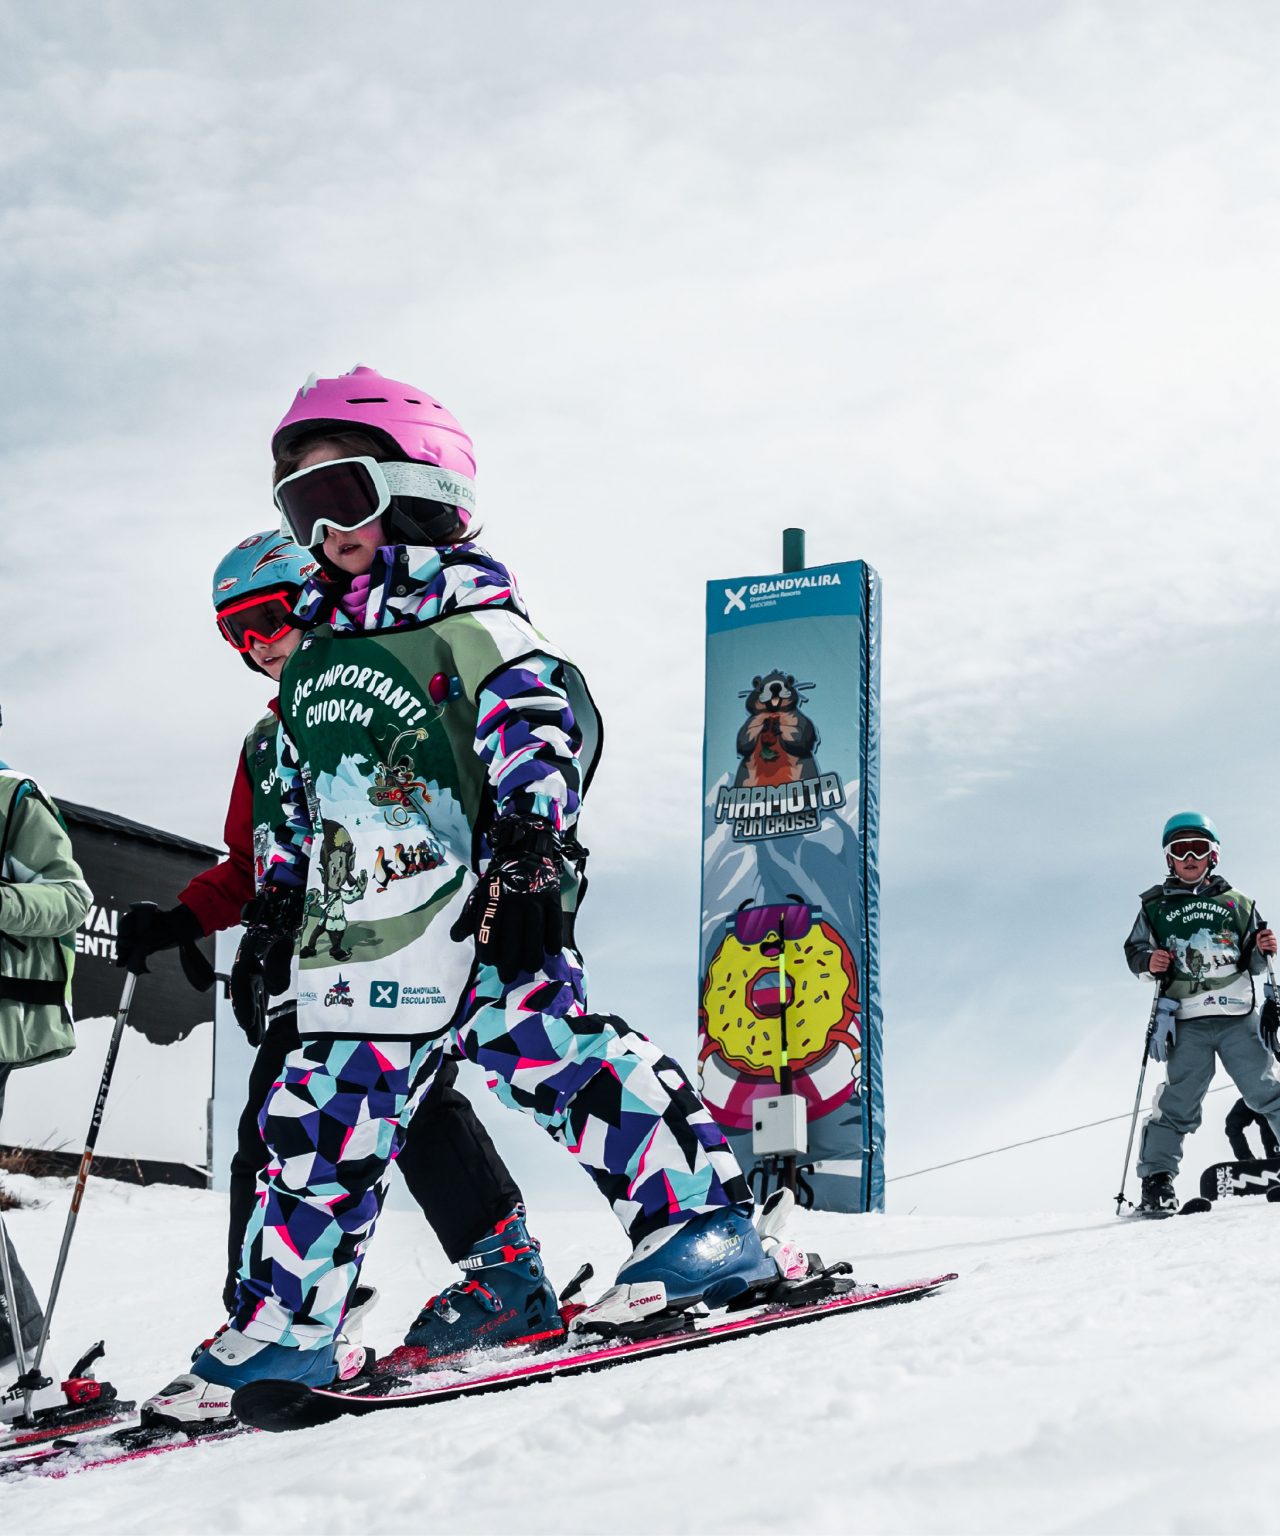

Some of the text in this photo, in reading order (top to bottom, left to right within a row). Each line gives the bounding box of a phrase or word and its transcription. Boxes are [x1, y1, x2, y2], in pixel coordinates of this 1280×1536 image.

[435, 478, 476, 503] WEDZ
[749, 573, 841, 595] GRANDVALIRA
[315, 663, 428, 727] IMPORTANT!
[260, 768, 276, 795] SÓ
[715, 774, 843, 819] MARMOTA
[734, 812, 817, 837] FUN CROSS
[1181, 901, 1231, 918] IMPORTANT!
[1182, 911, 1214, 924] CUIDA'M
[628, 1293, 662, 1309] ATOMIC
[198, 1401, 229, 1409] ATOMIC
